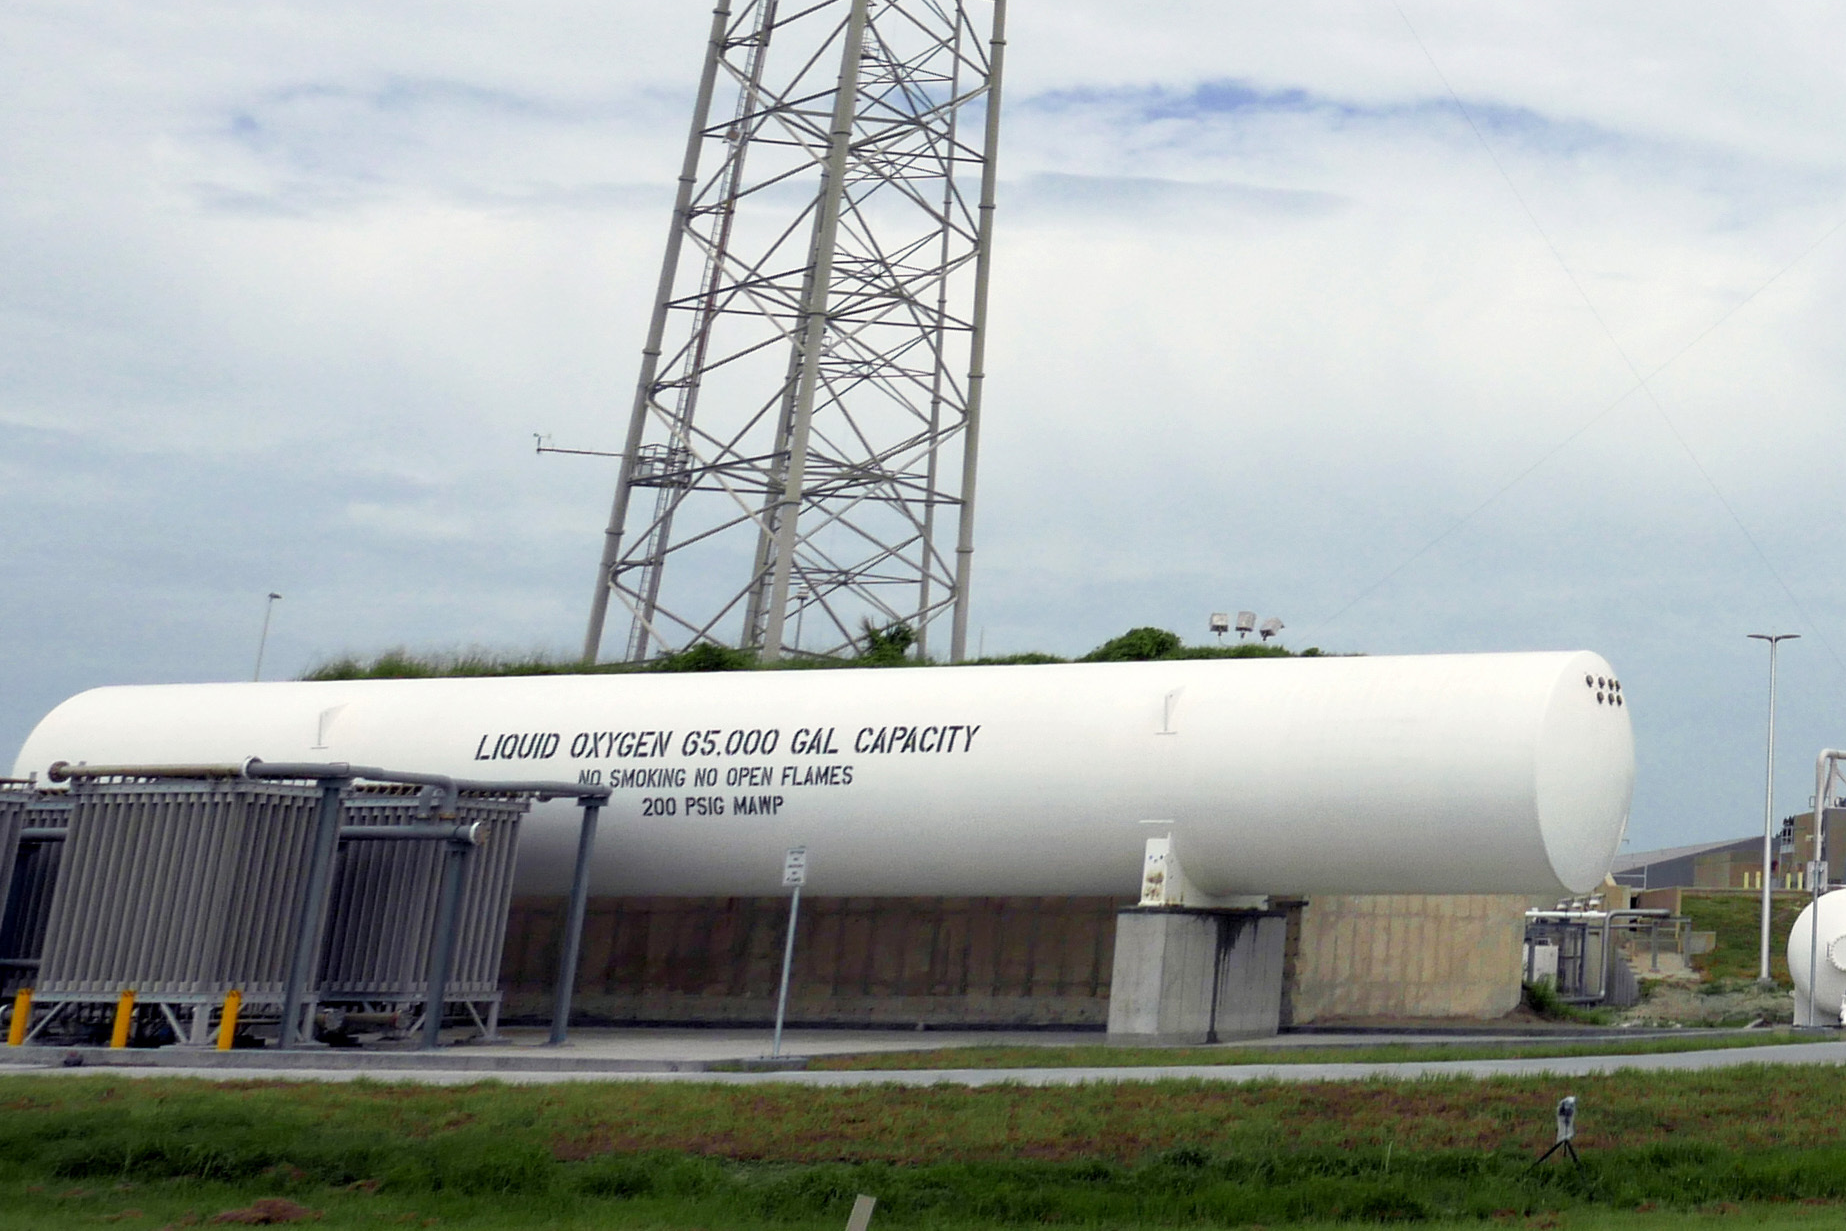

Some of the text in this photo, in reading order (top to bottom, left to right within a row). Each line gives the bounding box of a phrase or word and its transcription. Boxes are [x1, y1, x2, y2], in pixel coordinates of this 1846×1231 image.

[474, 733, 560, 760] LIQUID
[570, 731, 673, 758] OXYGEN
[791, 727, 839, 755] GAL
[854, 725, 981, 753] CAPACITY
[578, 766, 854, 788] NO SMOKING NO OPEN FLAMES
[642, 795, 784, 817] 200 PSIG MAWP
